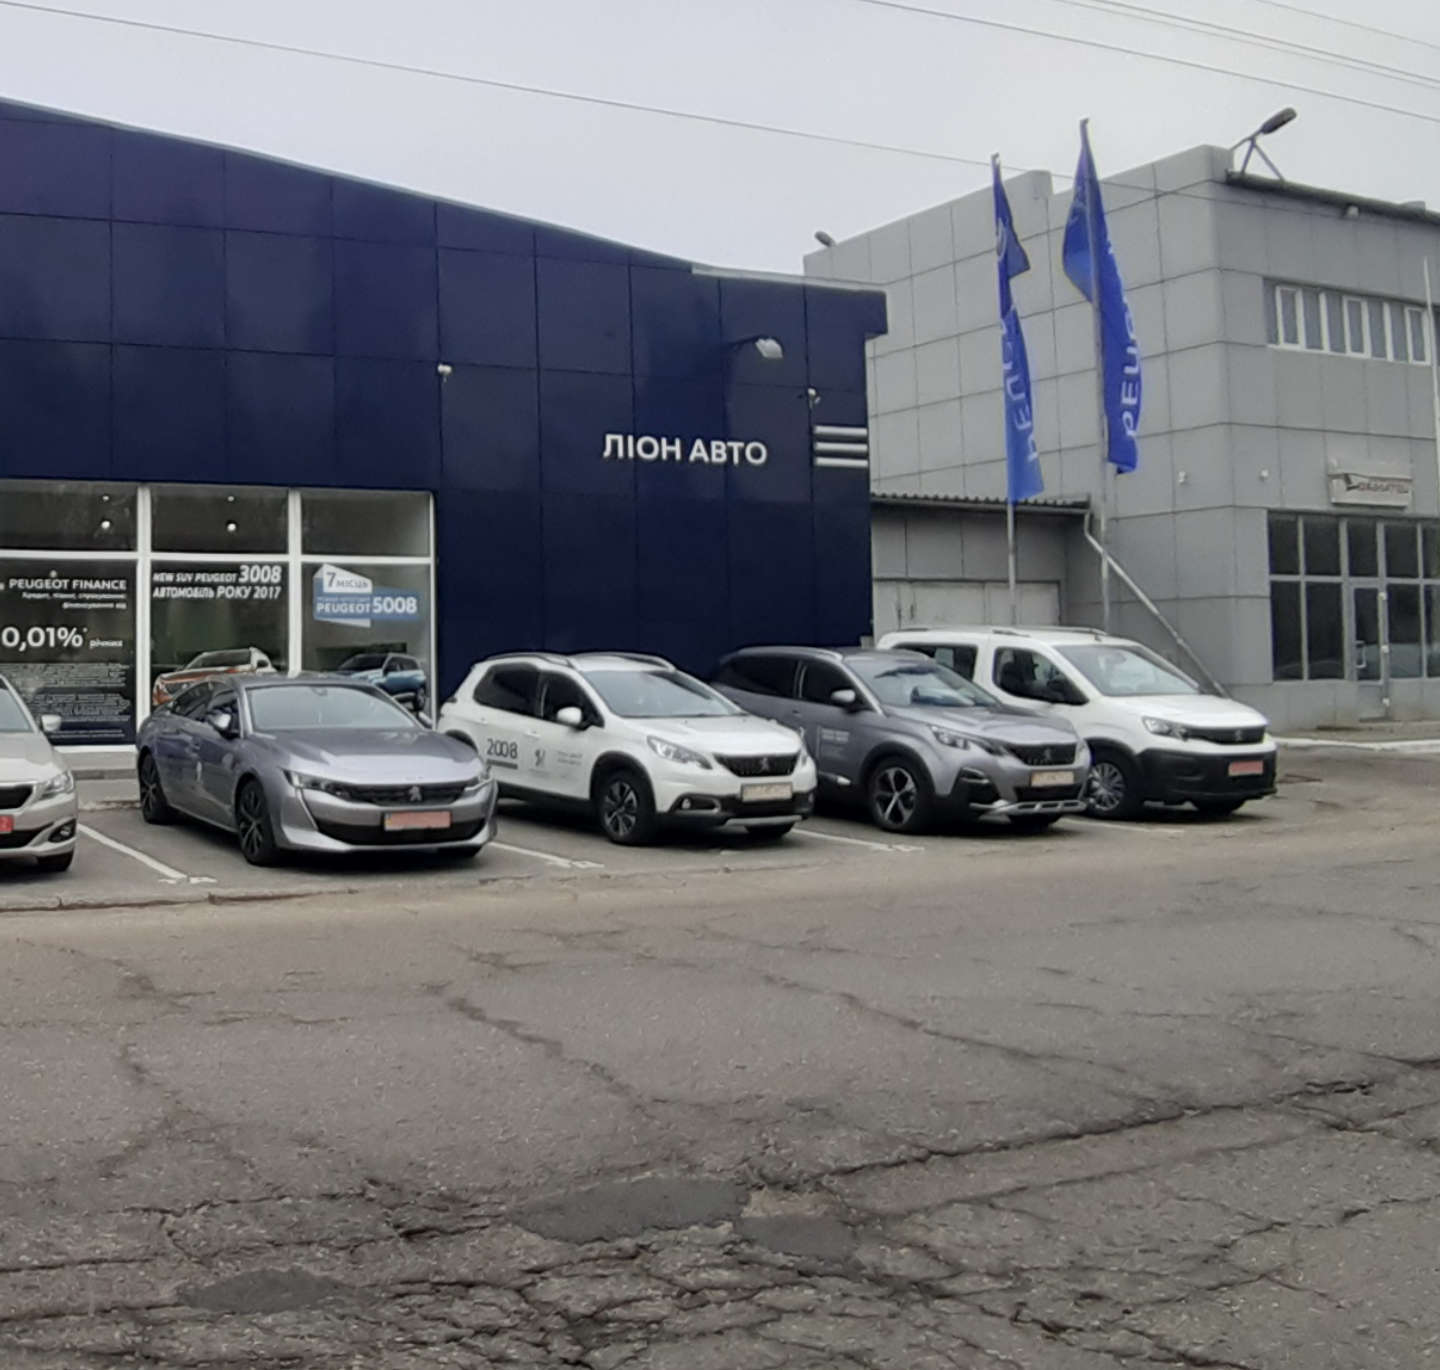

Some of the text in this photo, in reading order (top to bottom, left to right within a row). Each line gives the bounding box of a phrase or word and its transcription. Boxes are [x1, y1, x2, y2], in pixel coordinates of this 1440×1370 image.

[603, 433, 768, 465] ЛІОН АВТО
[195, 573, 239, 583] PEUGEOT
[239, 564, 282, 583] 3008
[326, 571, 337, 588] 7
[9, 578, 127, 590] PEUGEOT FINANCE
[216, 585, 252, 599] РОКУ
[253, 586, 281, 599] 2017
[316, 596, 417, 614] PEUGEOT 5008
[486, 738, 518, 760] 2008
